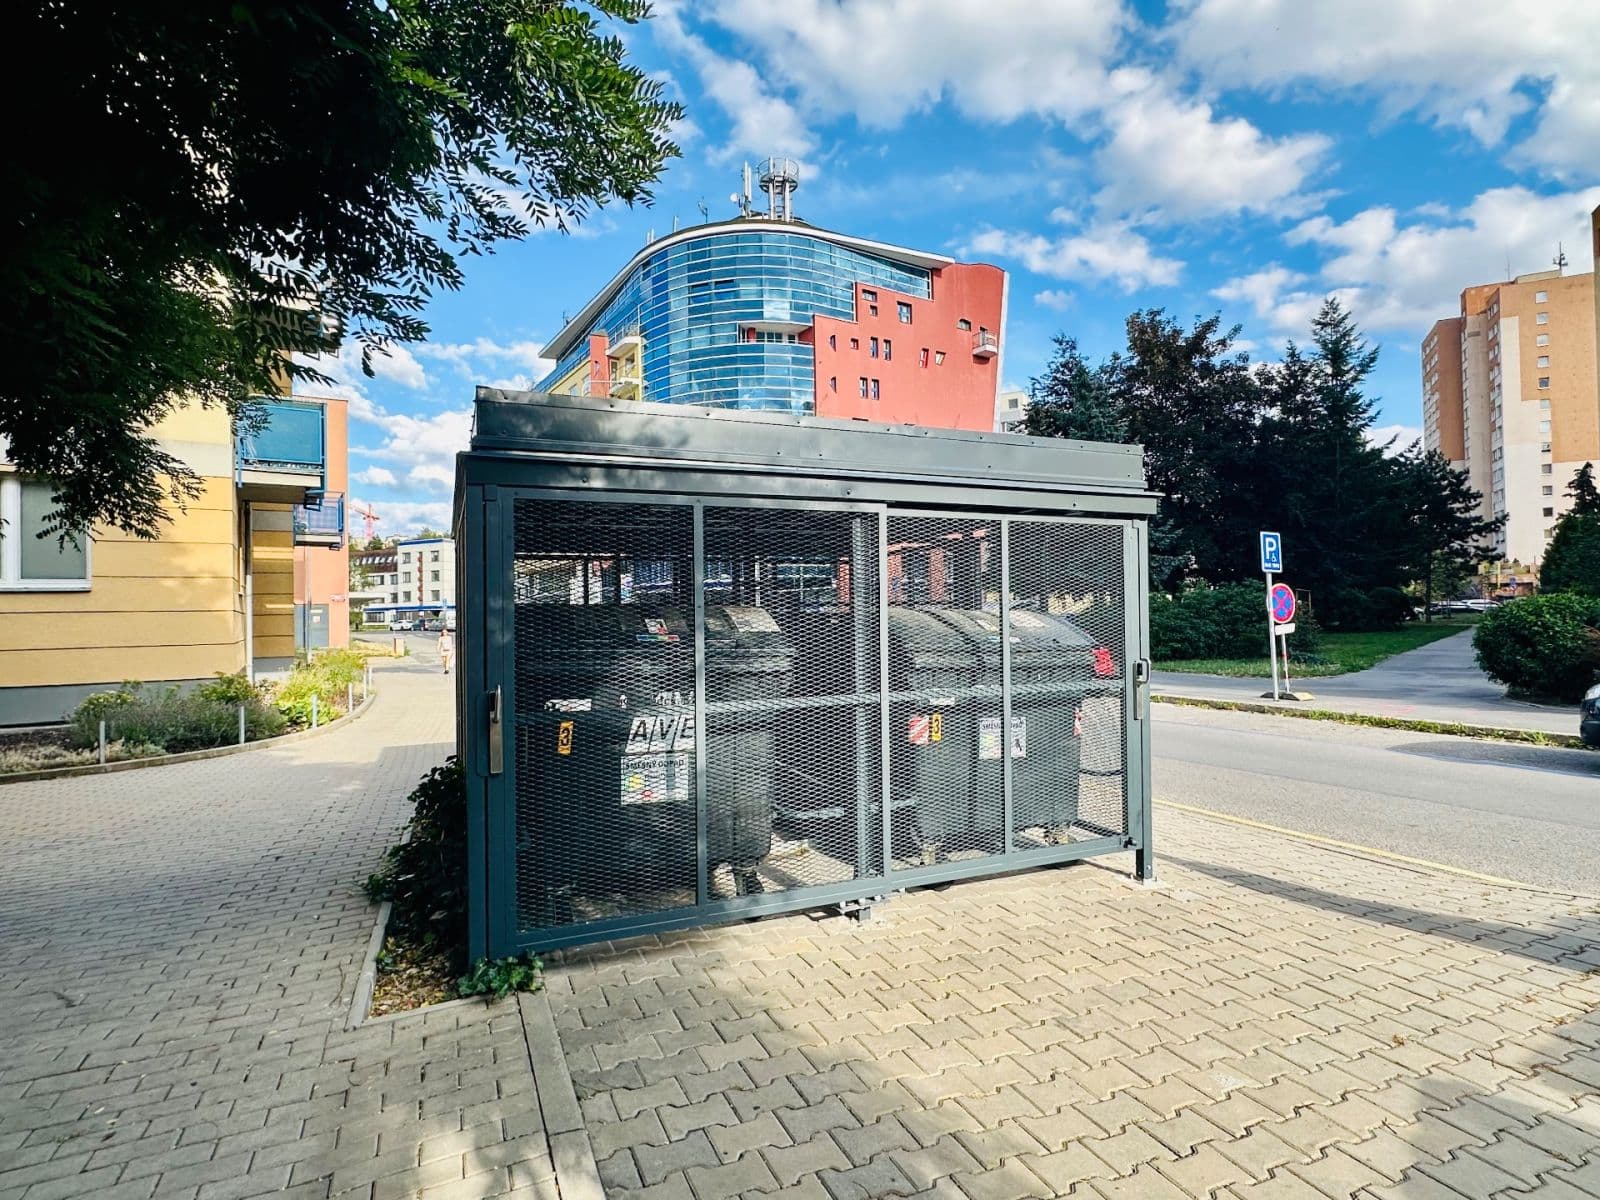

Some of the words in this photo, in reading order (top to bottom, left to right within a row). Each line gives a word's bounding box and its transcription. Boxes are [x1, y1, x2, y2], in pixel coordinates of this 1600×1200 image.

[1265, 537, 1277, 560] P
[560, 727, 571, 746] 3
[934, 719, 941, 735] 3
